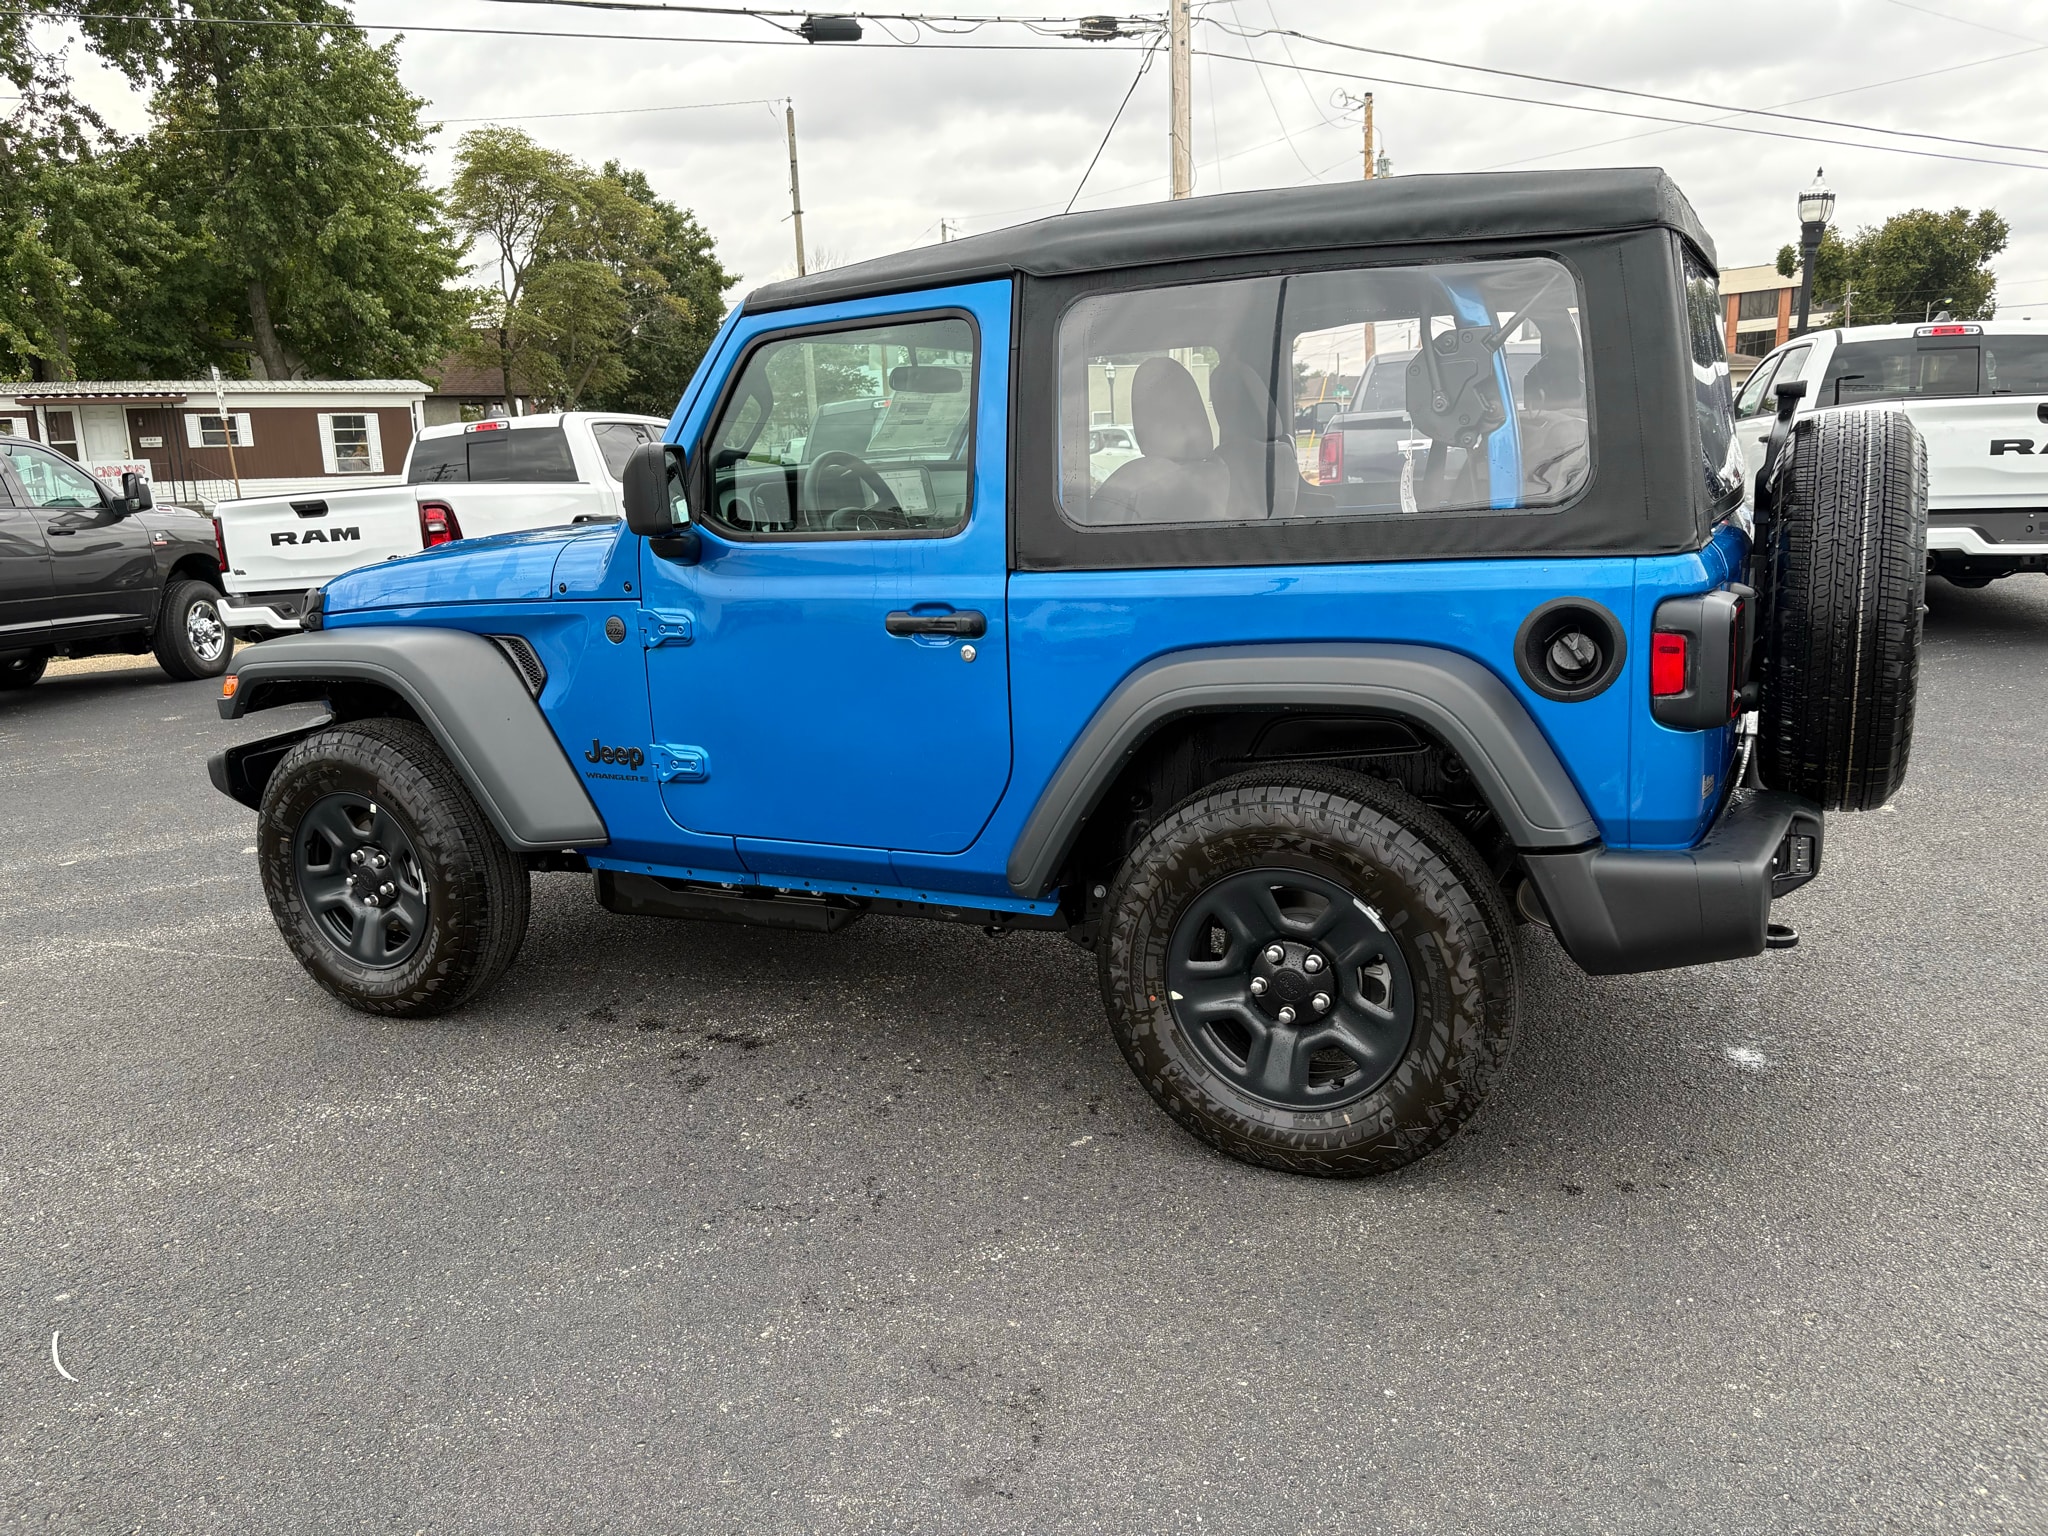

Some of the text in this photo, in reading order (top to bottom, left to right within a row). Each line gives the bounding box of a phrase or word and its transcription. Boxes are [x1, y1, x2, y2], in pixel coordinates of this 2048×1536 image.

[270, 527, 361, 546] RAM
[585, 738, 644, 771] Jeep
[586, 772, 638, 781] WRANGLER
